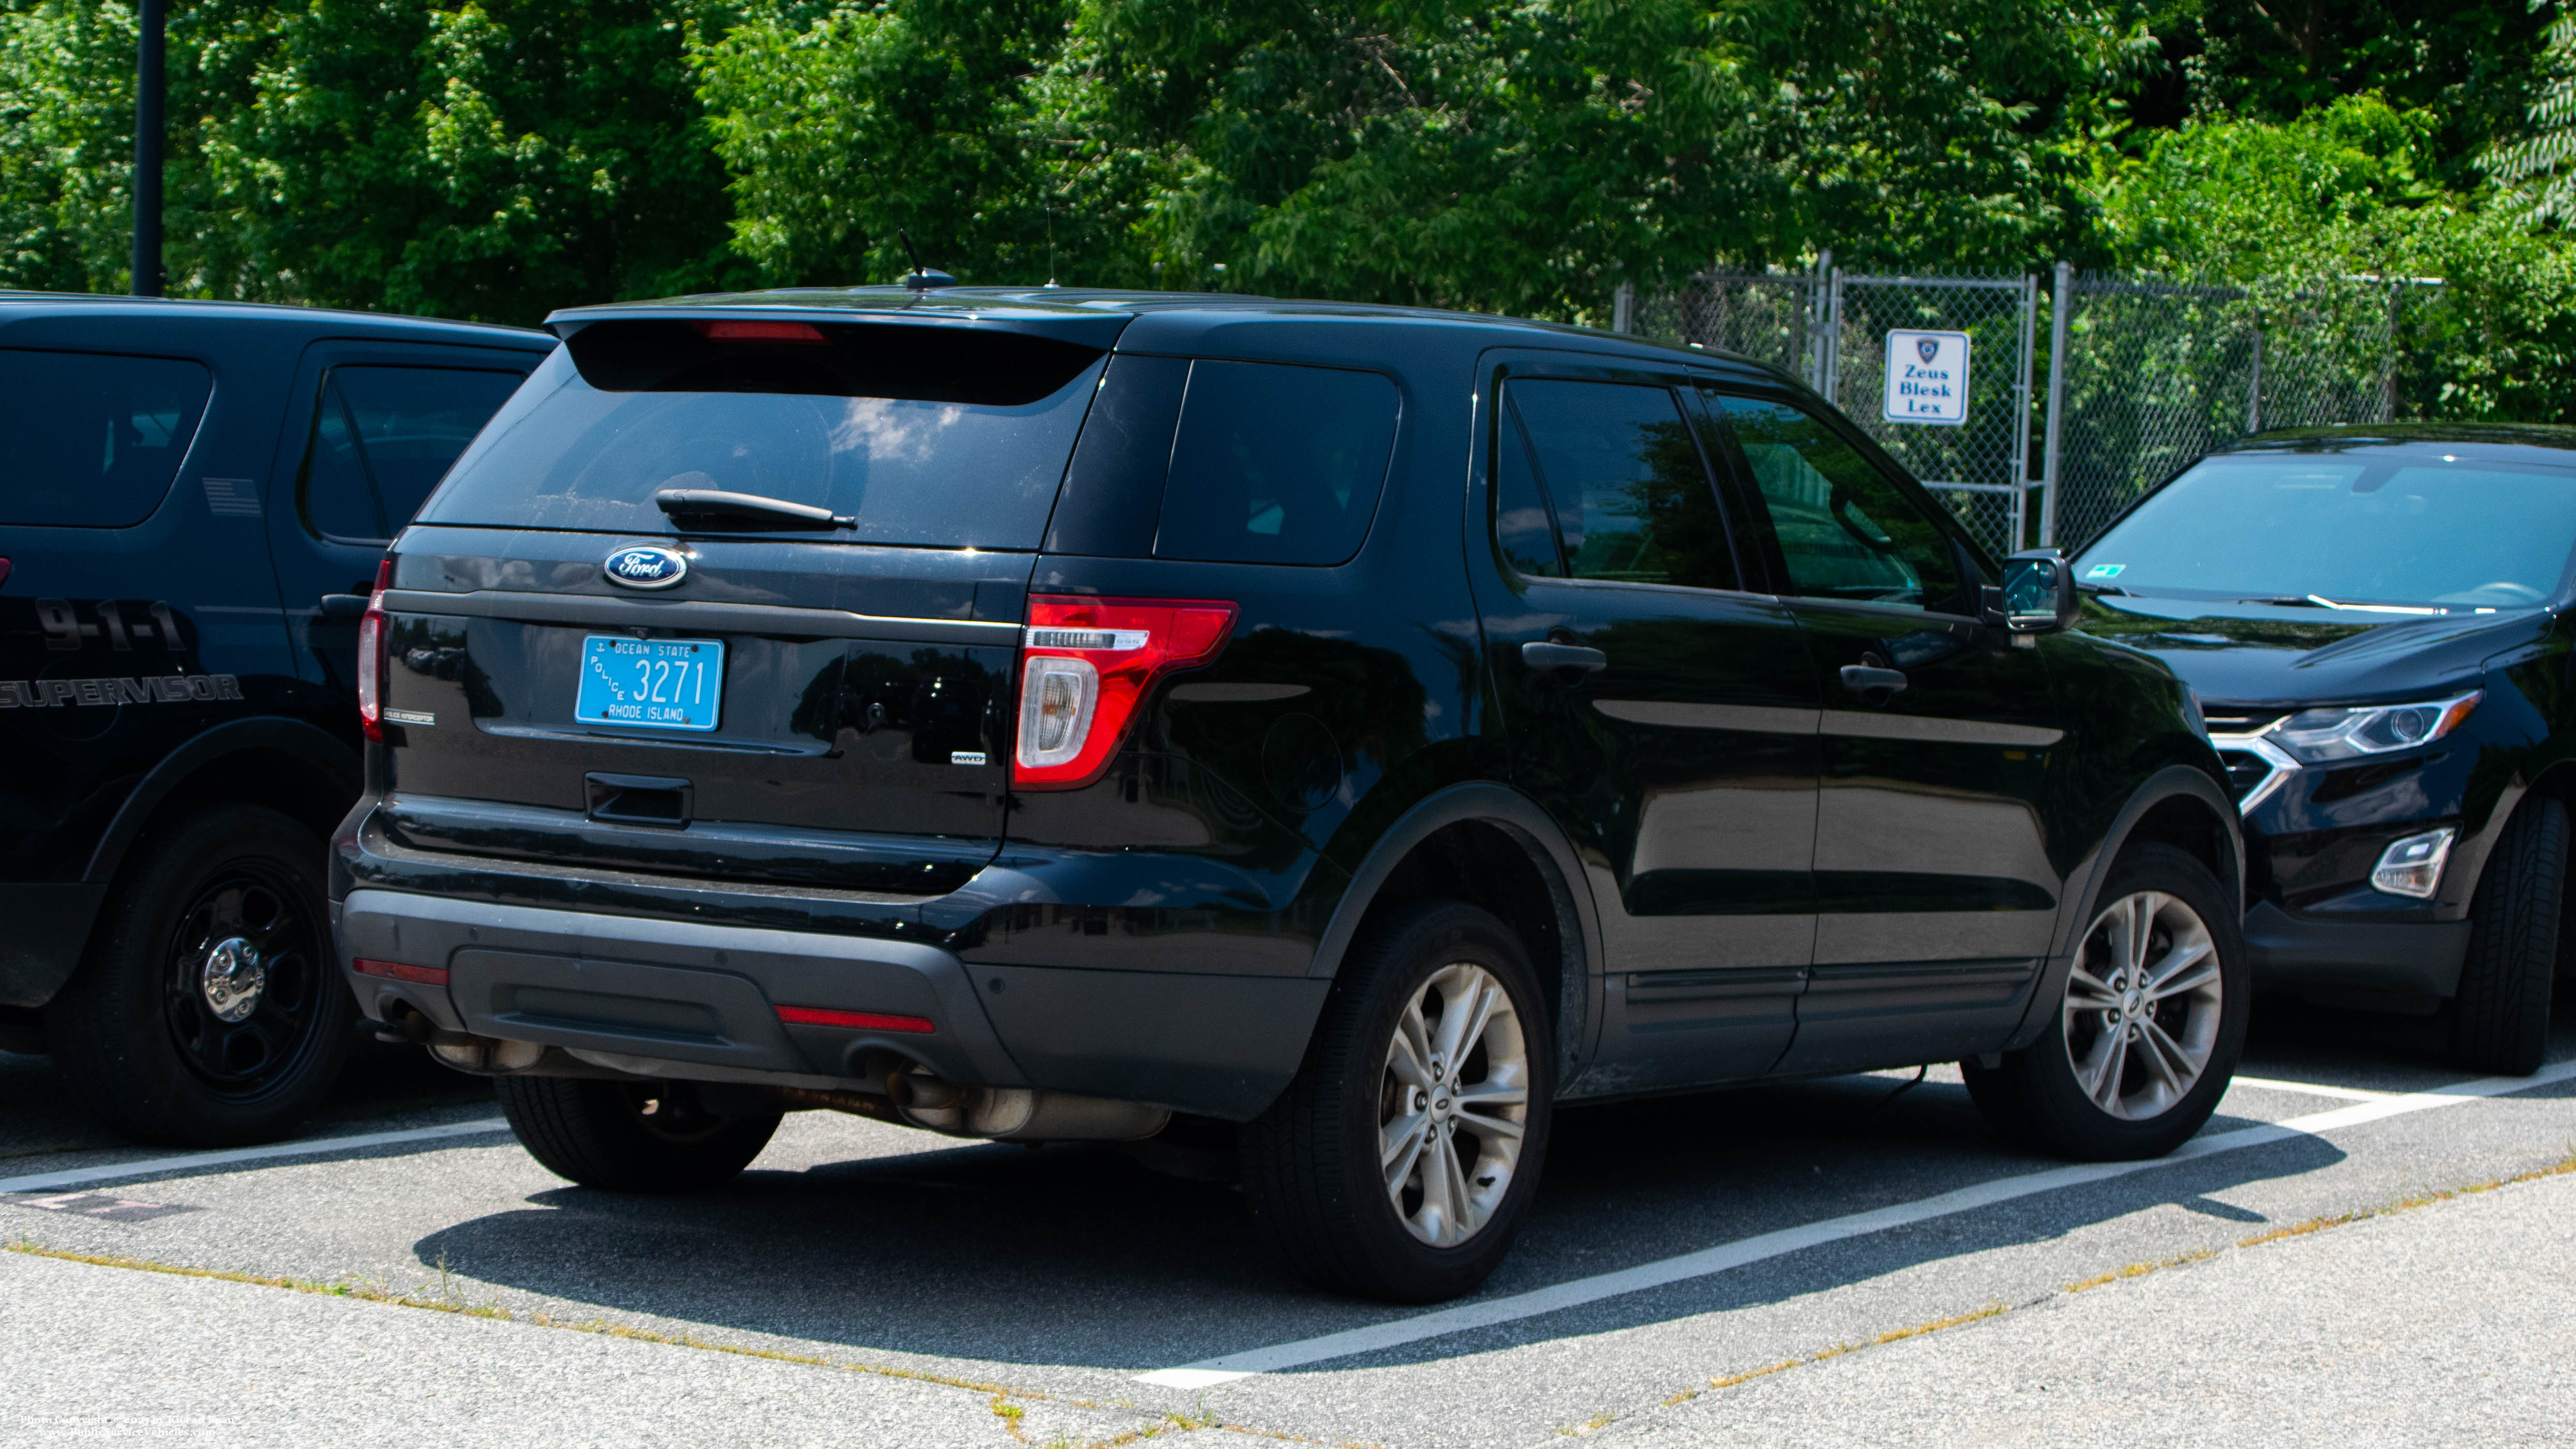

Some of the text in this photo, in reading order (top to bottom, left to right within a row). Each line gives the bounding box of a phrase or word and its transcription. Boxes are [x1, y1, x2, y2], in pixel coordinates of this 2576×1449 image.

[1905, 364, 1949, 380] Zeus
[1900, 381, 1952, 397] Blesk
[1908, 398, 1941, 413] Lex
[619, 552, 664, 578] Ford
[35, 597, 187, 651] 9-1-1
[615, 643, 690, 658] OCEAN STATE
[590, 655, 624, 701] POLICE
[633, 659, 704, 705] 3271
[0, 674, 245, 708] SUPERVISOR
[608, 704, 683, 721] RHODE ISLAND
